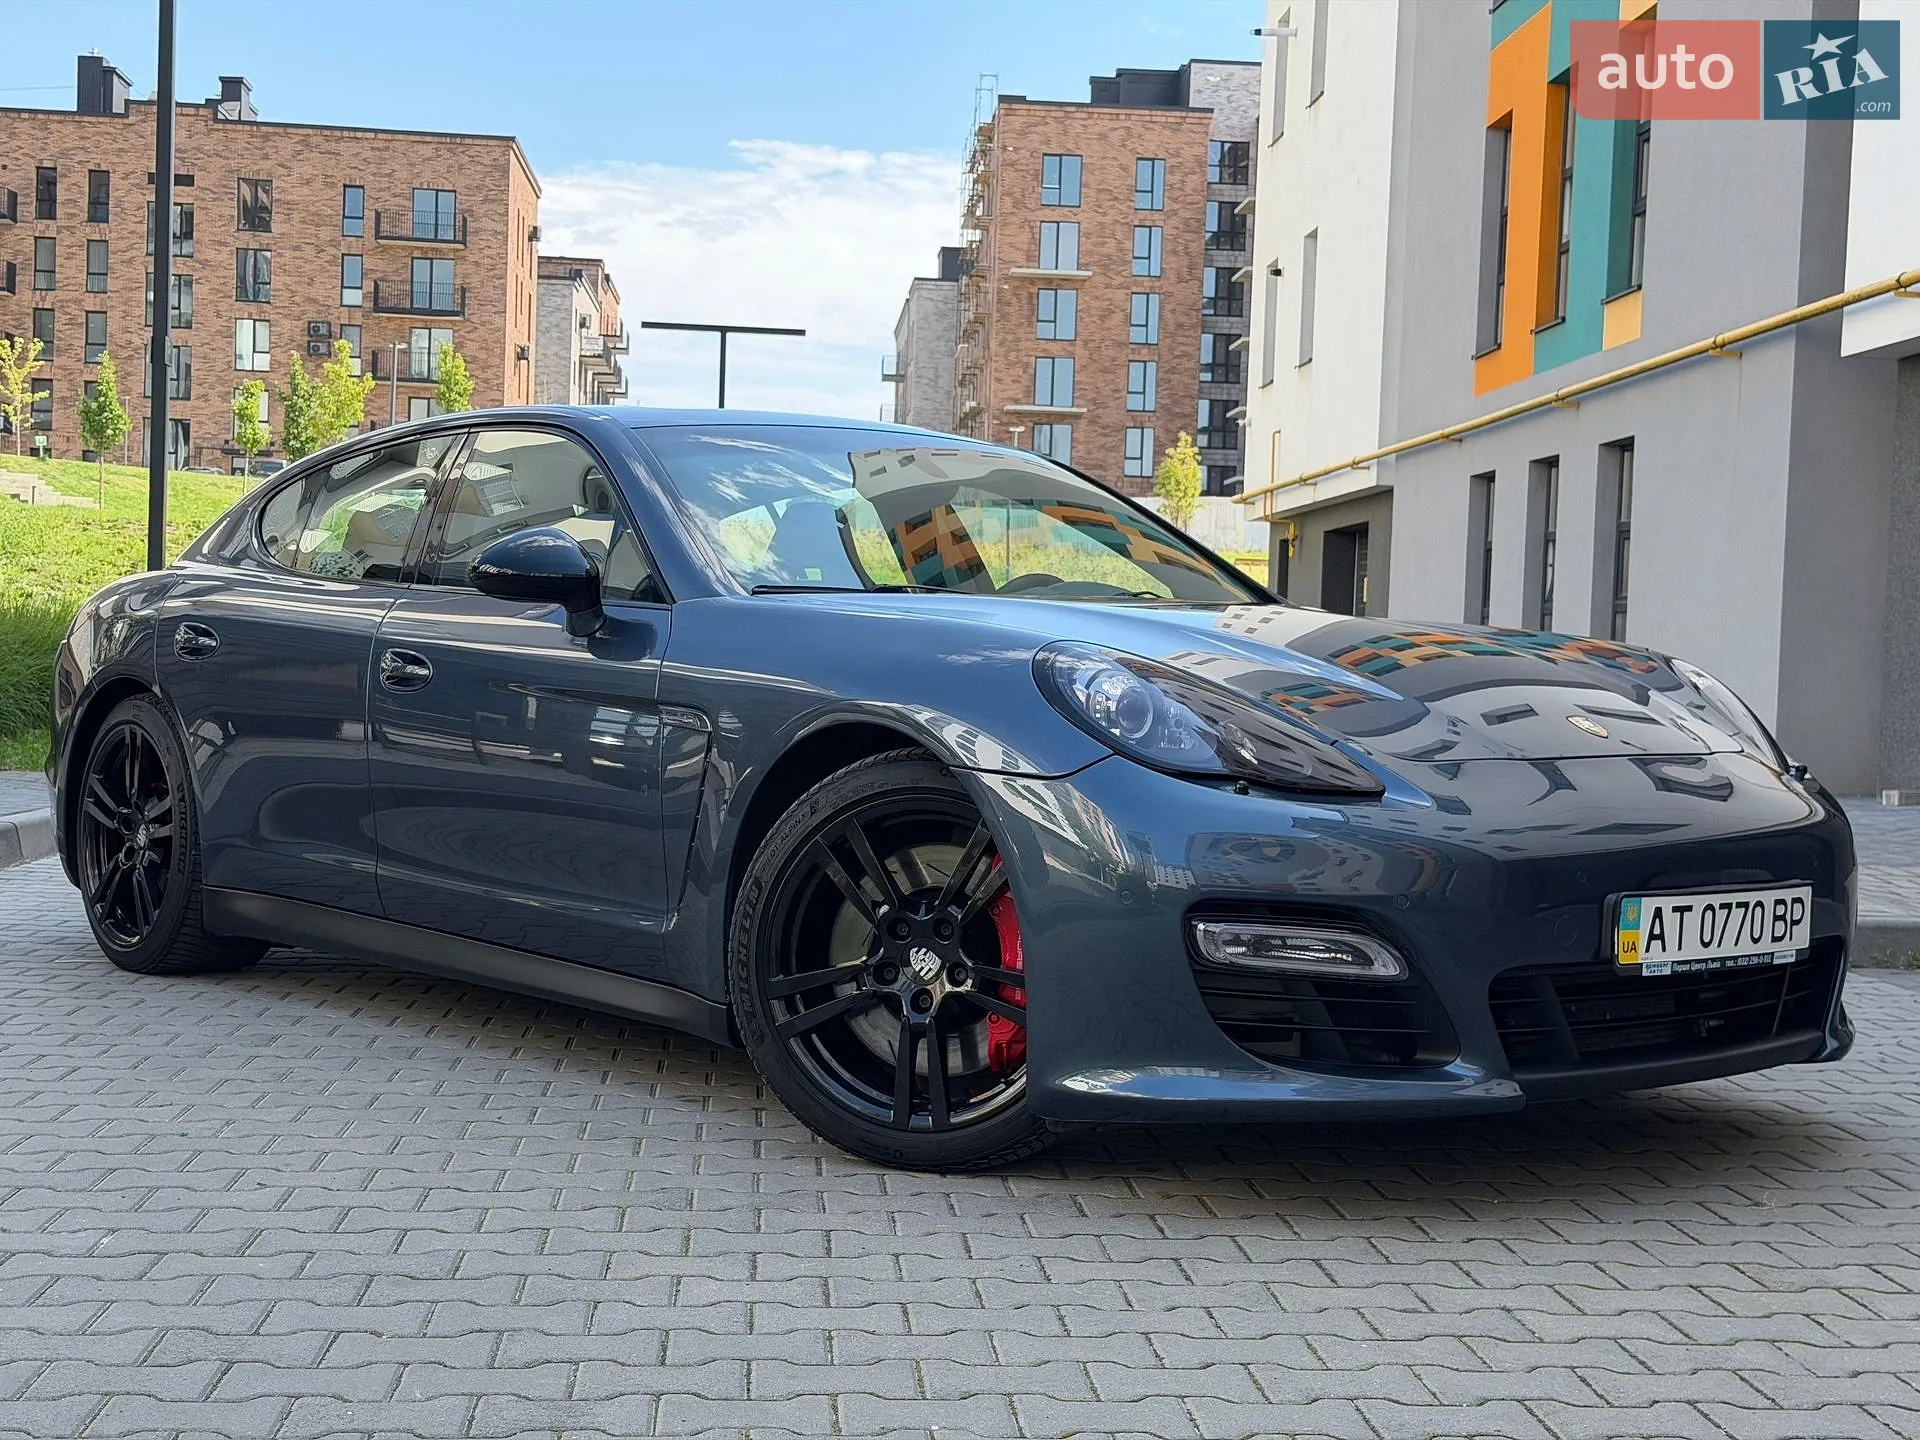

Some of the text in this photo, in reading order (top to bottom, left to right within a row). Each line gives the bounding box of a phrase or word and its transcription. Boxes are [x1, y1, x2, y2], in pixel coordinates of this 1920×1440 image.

[737, 880, 761, 1013] MICHELIN
[1622, 941, 1637, 954] UA
[1644, 896, 1805, 953] AT 0770 BP
